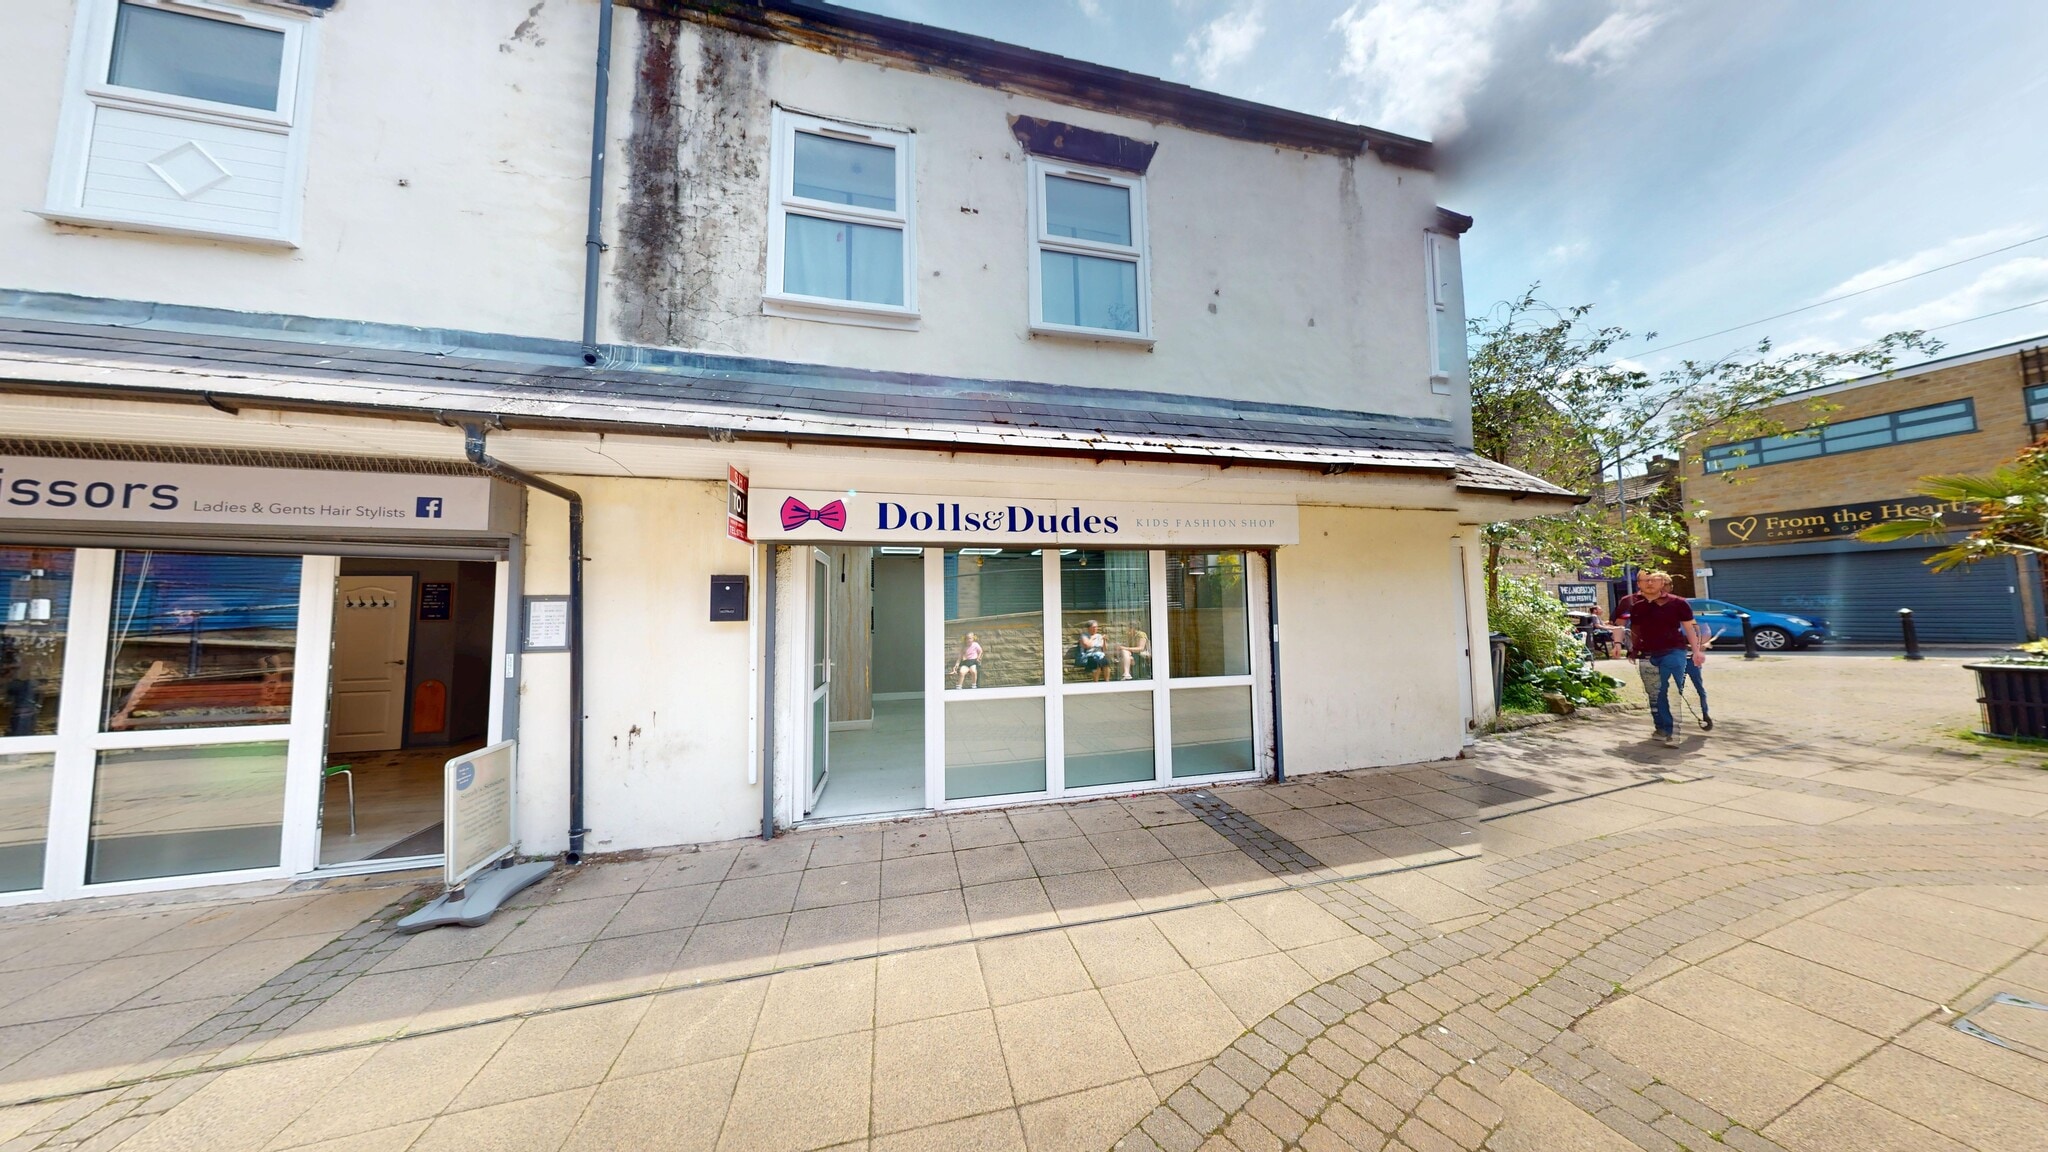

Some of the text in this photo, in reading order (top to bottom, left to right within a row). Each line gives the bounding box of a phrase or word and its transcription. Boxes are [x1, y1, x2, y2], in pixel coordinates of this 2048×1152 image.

[193, 500, 406, 520] Ladies & Gents Hair Stylists
[1765, 497, 1962, 530] From the Heart
[1136, 518, 1275, 528] KIDS FASHION SHOP
[1767, 528, 1814, 538] CARDS
